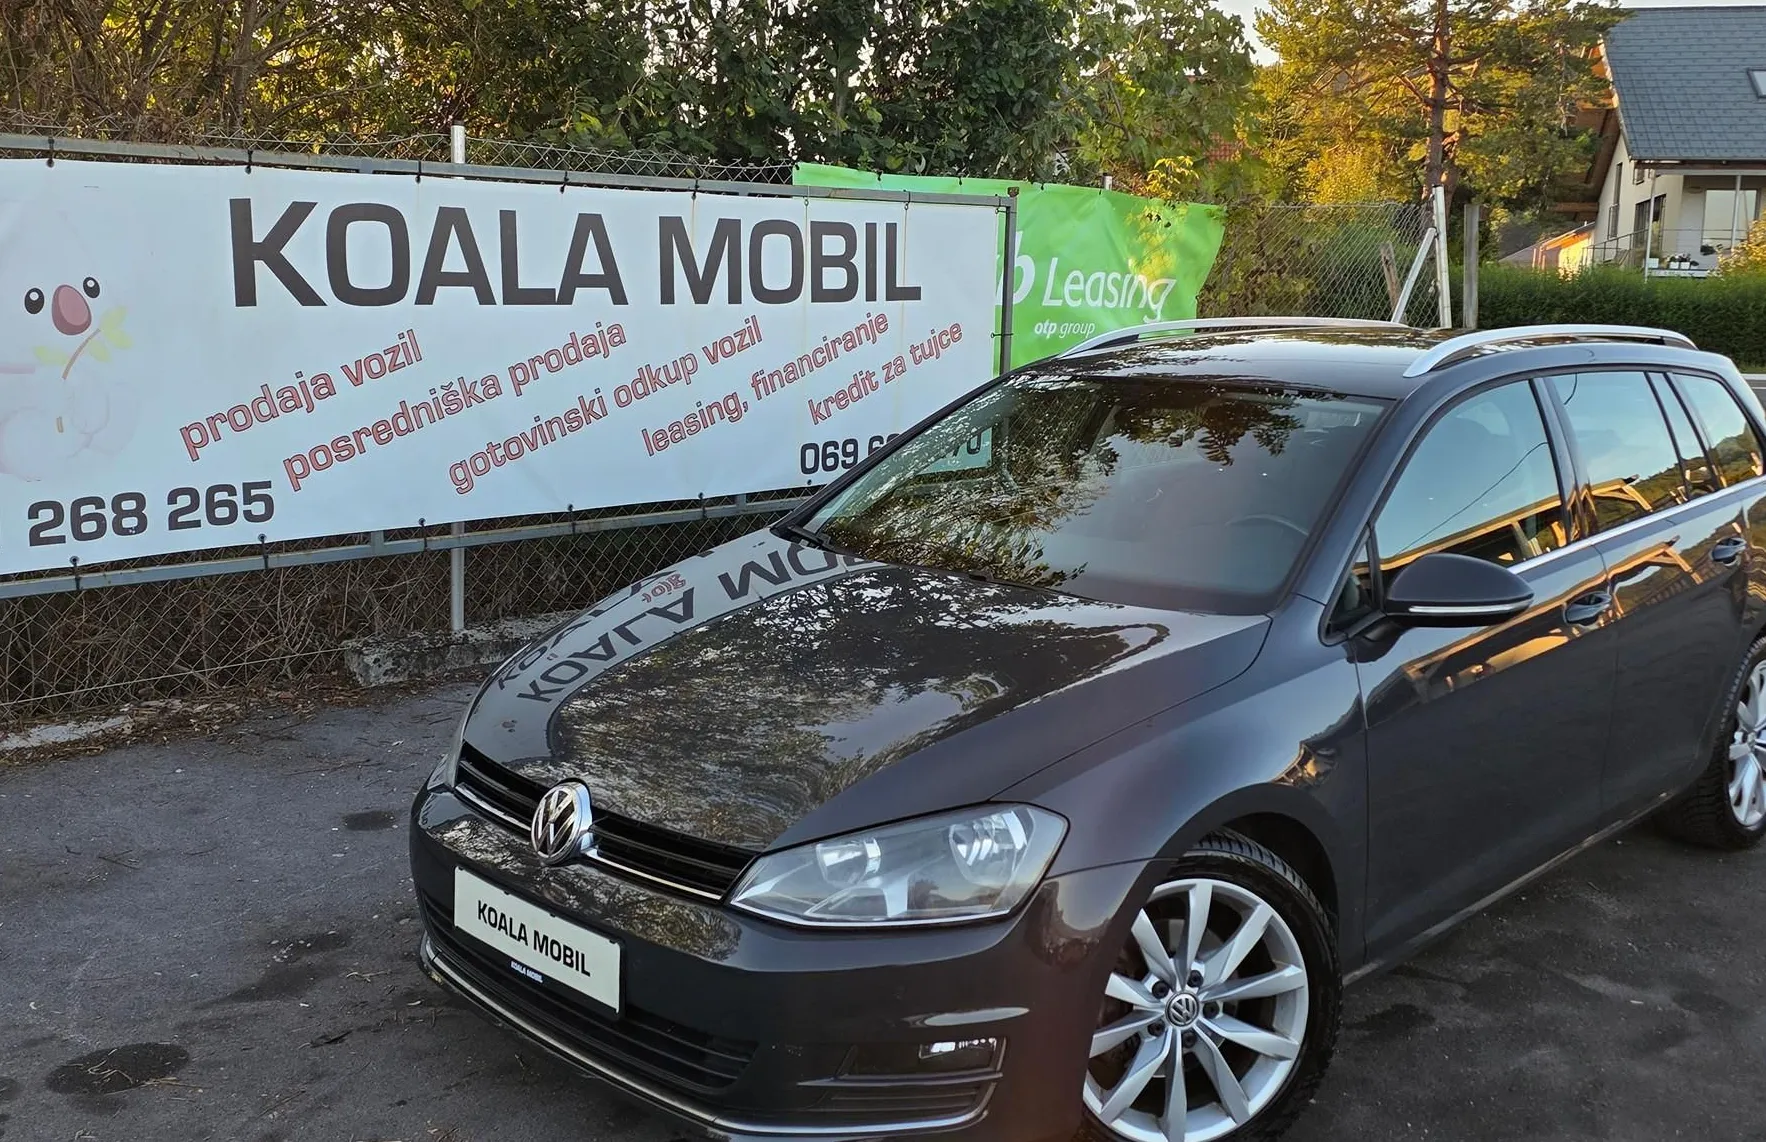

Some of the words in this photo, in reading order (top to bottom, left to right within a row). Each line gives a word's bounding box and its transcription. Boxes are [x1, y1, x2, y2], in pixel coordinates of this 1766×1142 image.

[229, 198, 629, 307] KOALA
[659, 216, 921, 305] MOBIL
[1042, 257, 1177, 323] Leasing
[808, 369, 879, 425] kredit
[881, 355, 908, 384] za
[910, 322, 963, 366] tujce
[1034, 319, 1057, 339] otp
[1059, 322, 1095, 339] group
[179, 371, 337, 462] prodaja
[340, 328, 422, 387] vozil
[283, 376, 503, 492] posredniška
[508, 321, 627, 396] prodaja
[449, 387, 609, 495] gotovinski
[613, 352, 699, 408] odkup
[702, 315, 763, 366] vozil
[641, 391, 749, 457] leasing,
[750, 311, 889, 400] financiranje
[800, 438, 859, 475] 069
[27, 491, 148, 547] 268
[167, 480, 275, 531] 265
[478, 900, 529, 946] KOALA
[533, 929, 591, 977] MOBIL
